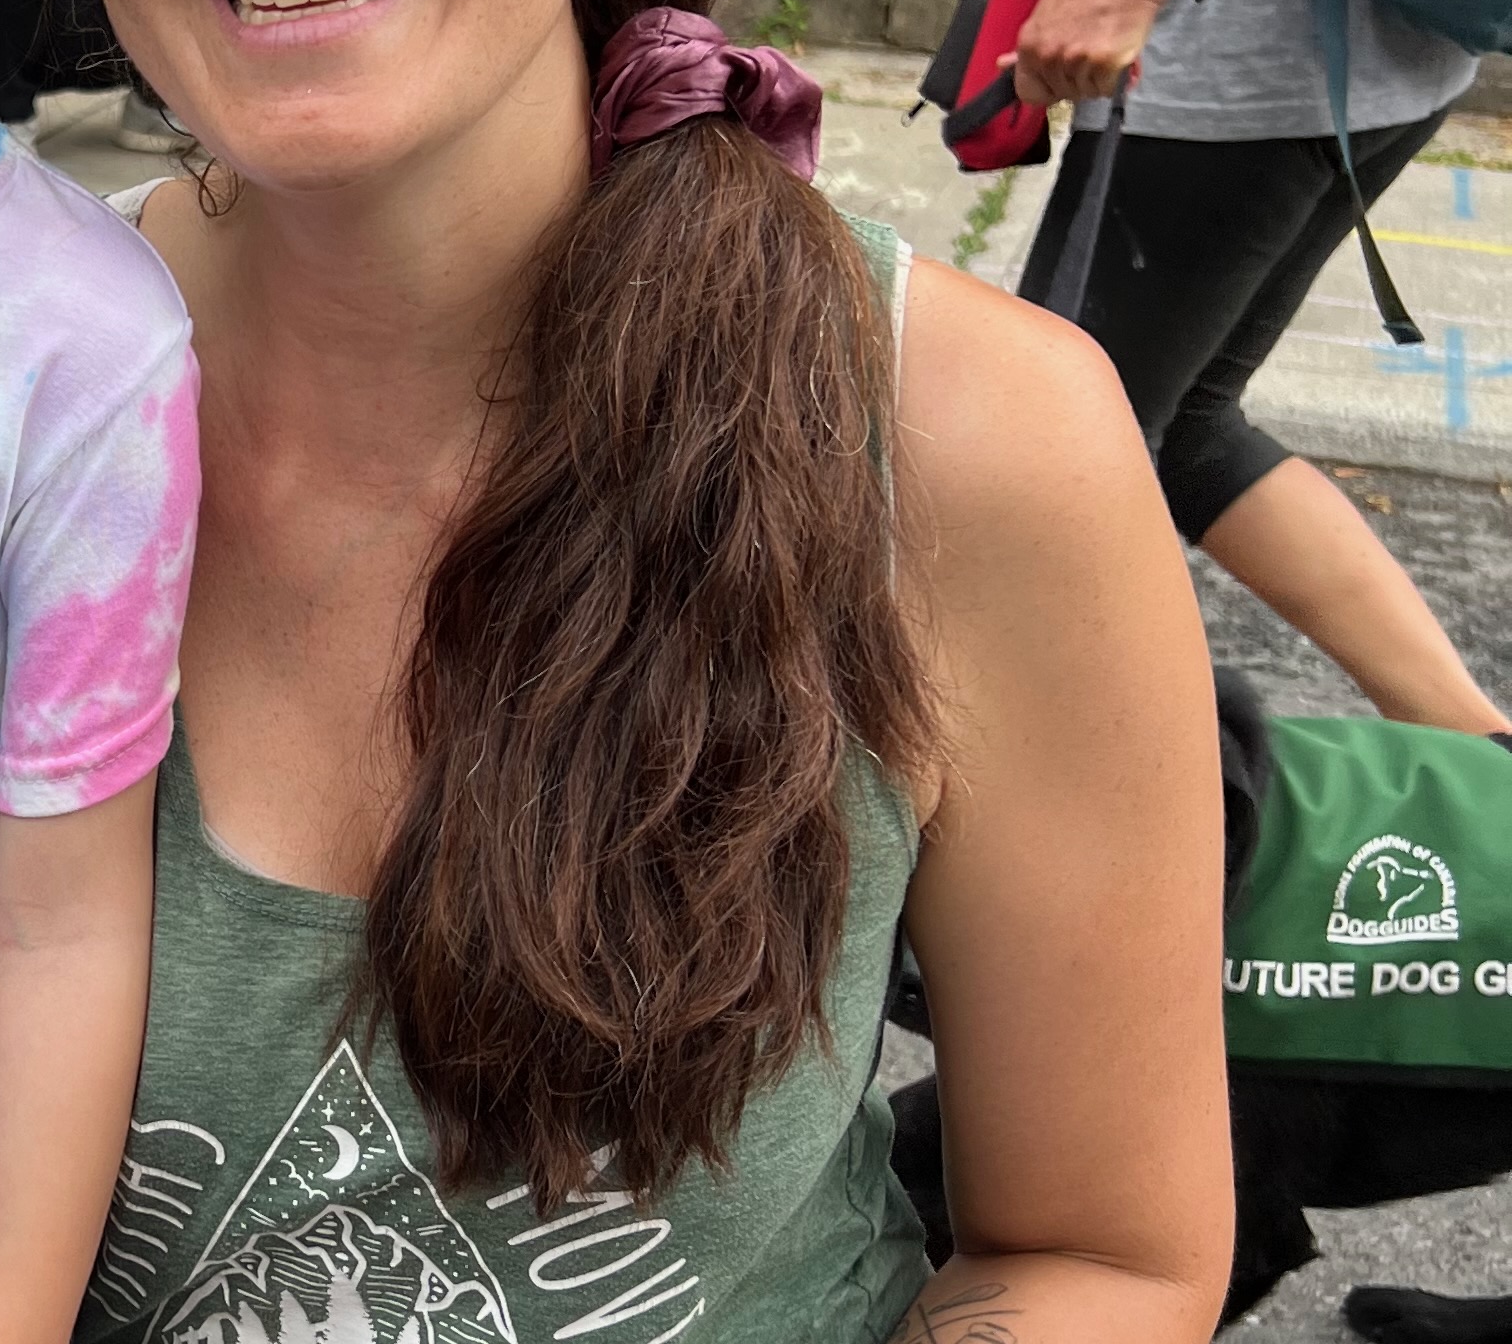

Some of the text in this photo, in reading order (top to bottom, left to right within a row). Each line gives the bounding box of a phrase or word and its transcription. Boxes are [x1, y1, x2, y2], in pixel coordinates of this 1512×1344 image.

[1222, 958, 1512, 998] UTURE DOG G
